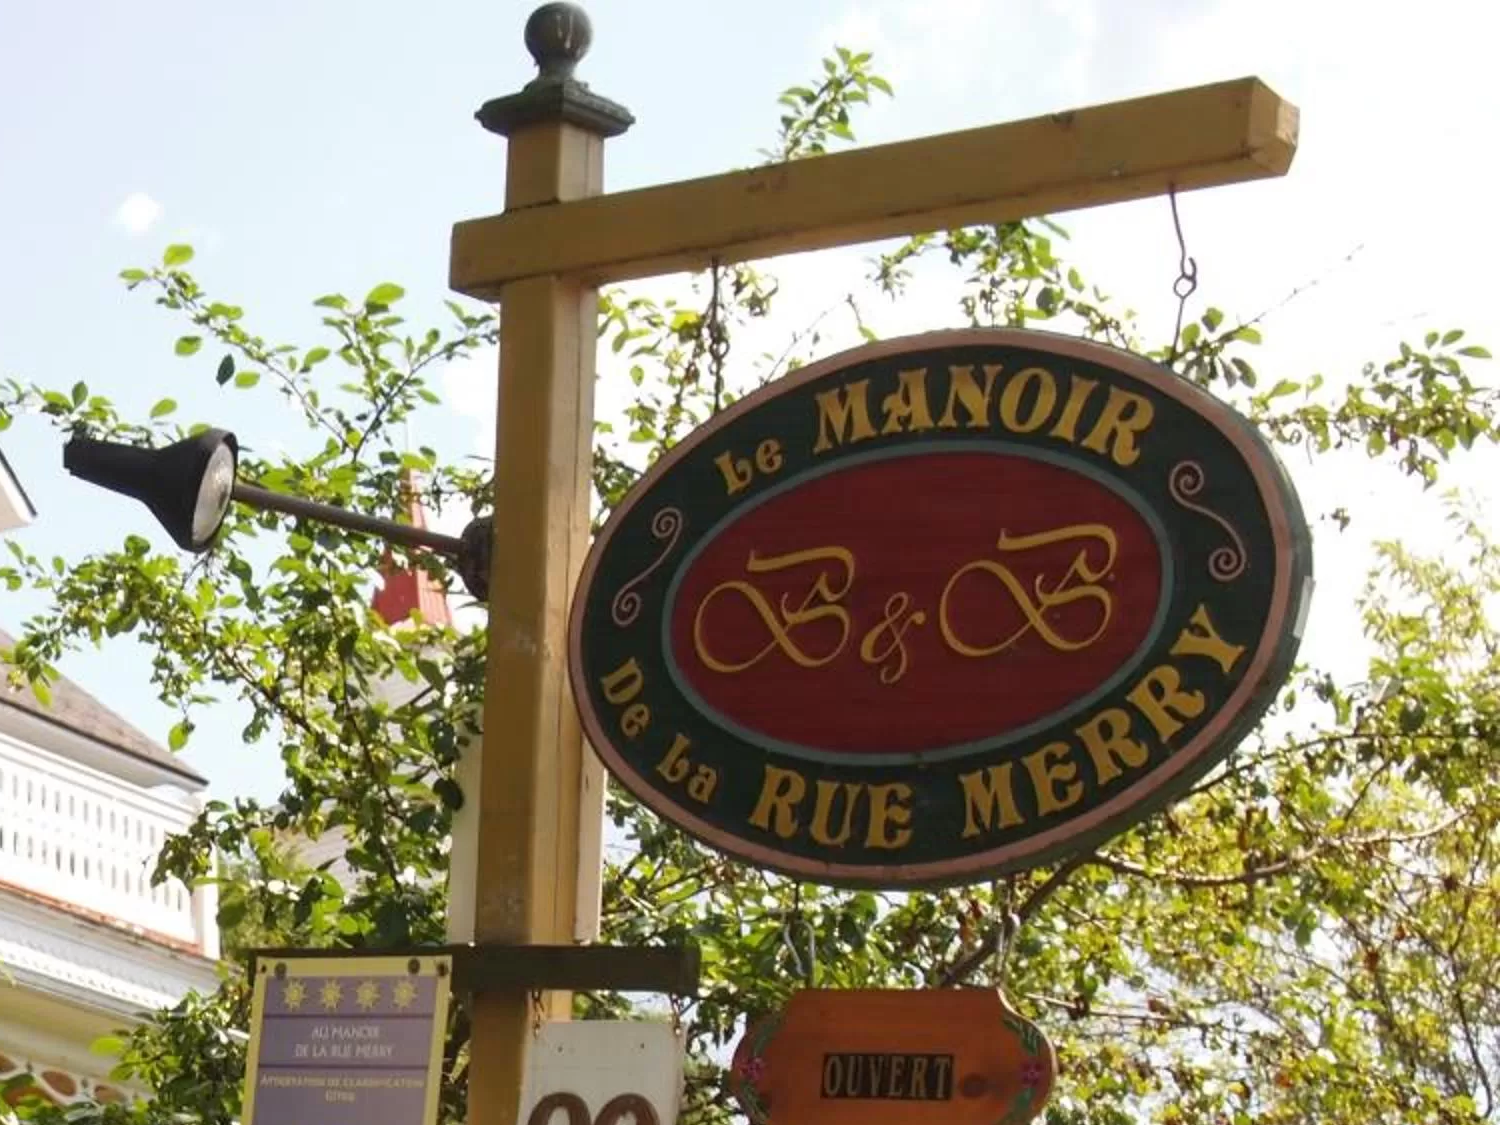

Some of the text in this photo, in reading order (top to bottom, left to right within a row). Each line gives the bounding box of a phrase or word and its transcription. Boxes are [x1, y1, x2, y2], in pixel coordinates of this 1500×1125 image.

[813, 364, 1156, 468] MANOIR
[601, 656, 652, 738] De
[748, 761, 914, 850] RUE
[958, 603, 1248, 841] MERRY
[312, 1043, 328, 1058] LA
[823, 1055, 953, 1099] OUVERT
